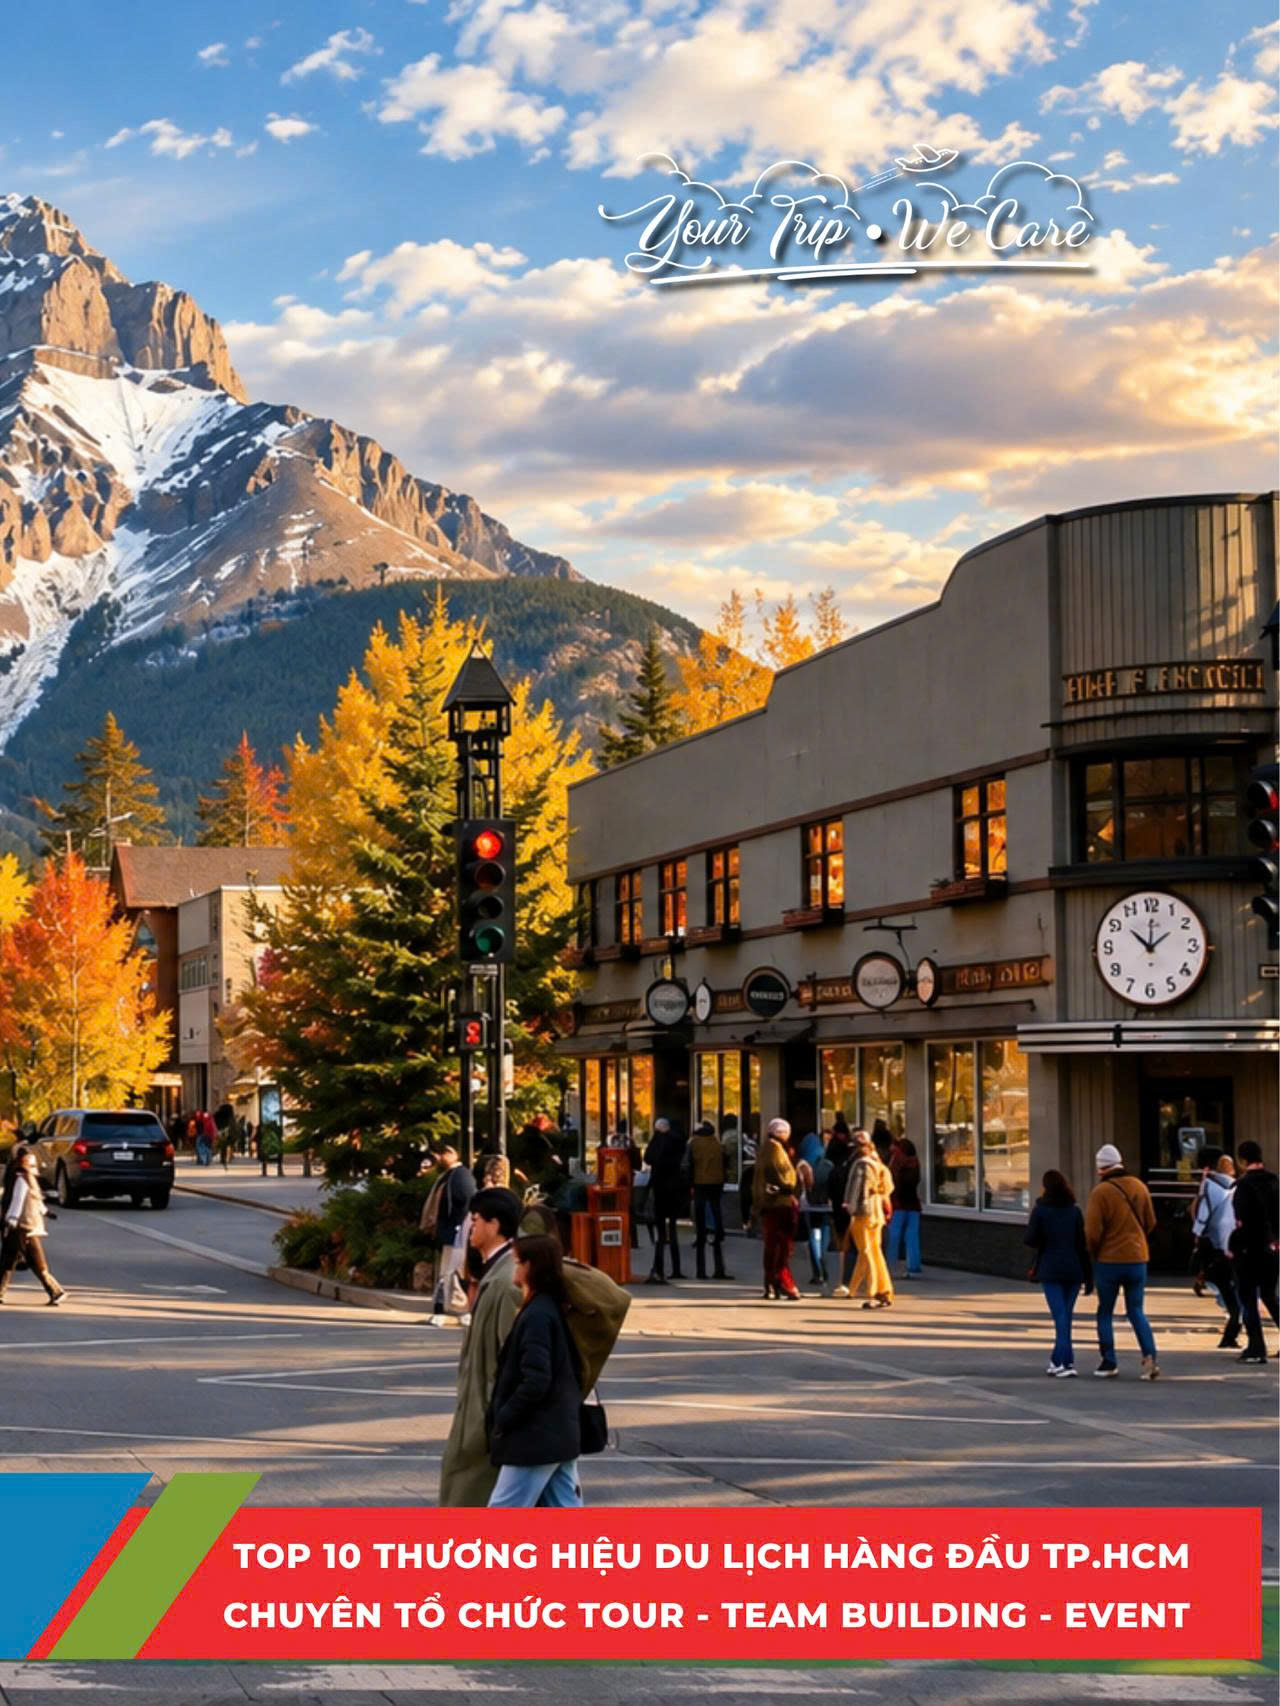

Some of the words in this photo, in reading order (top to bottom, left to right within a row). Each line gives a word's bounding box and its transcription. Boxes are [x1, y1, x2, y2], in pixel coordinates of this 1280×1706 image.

[1180, 917, 1192, 931] 2
[1187, 938, 1200, 954] 3
[1126, 977, 1136, 994] 7
[1144, 982, 1156, 999] 6
[1166, 976, 1177, 993] 5
